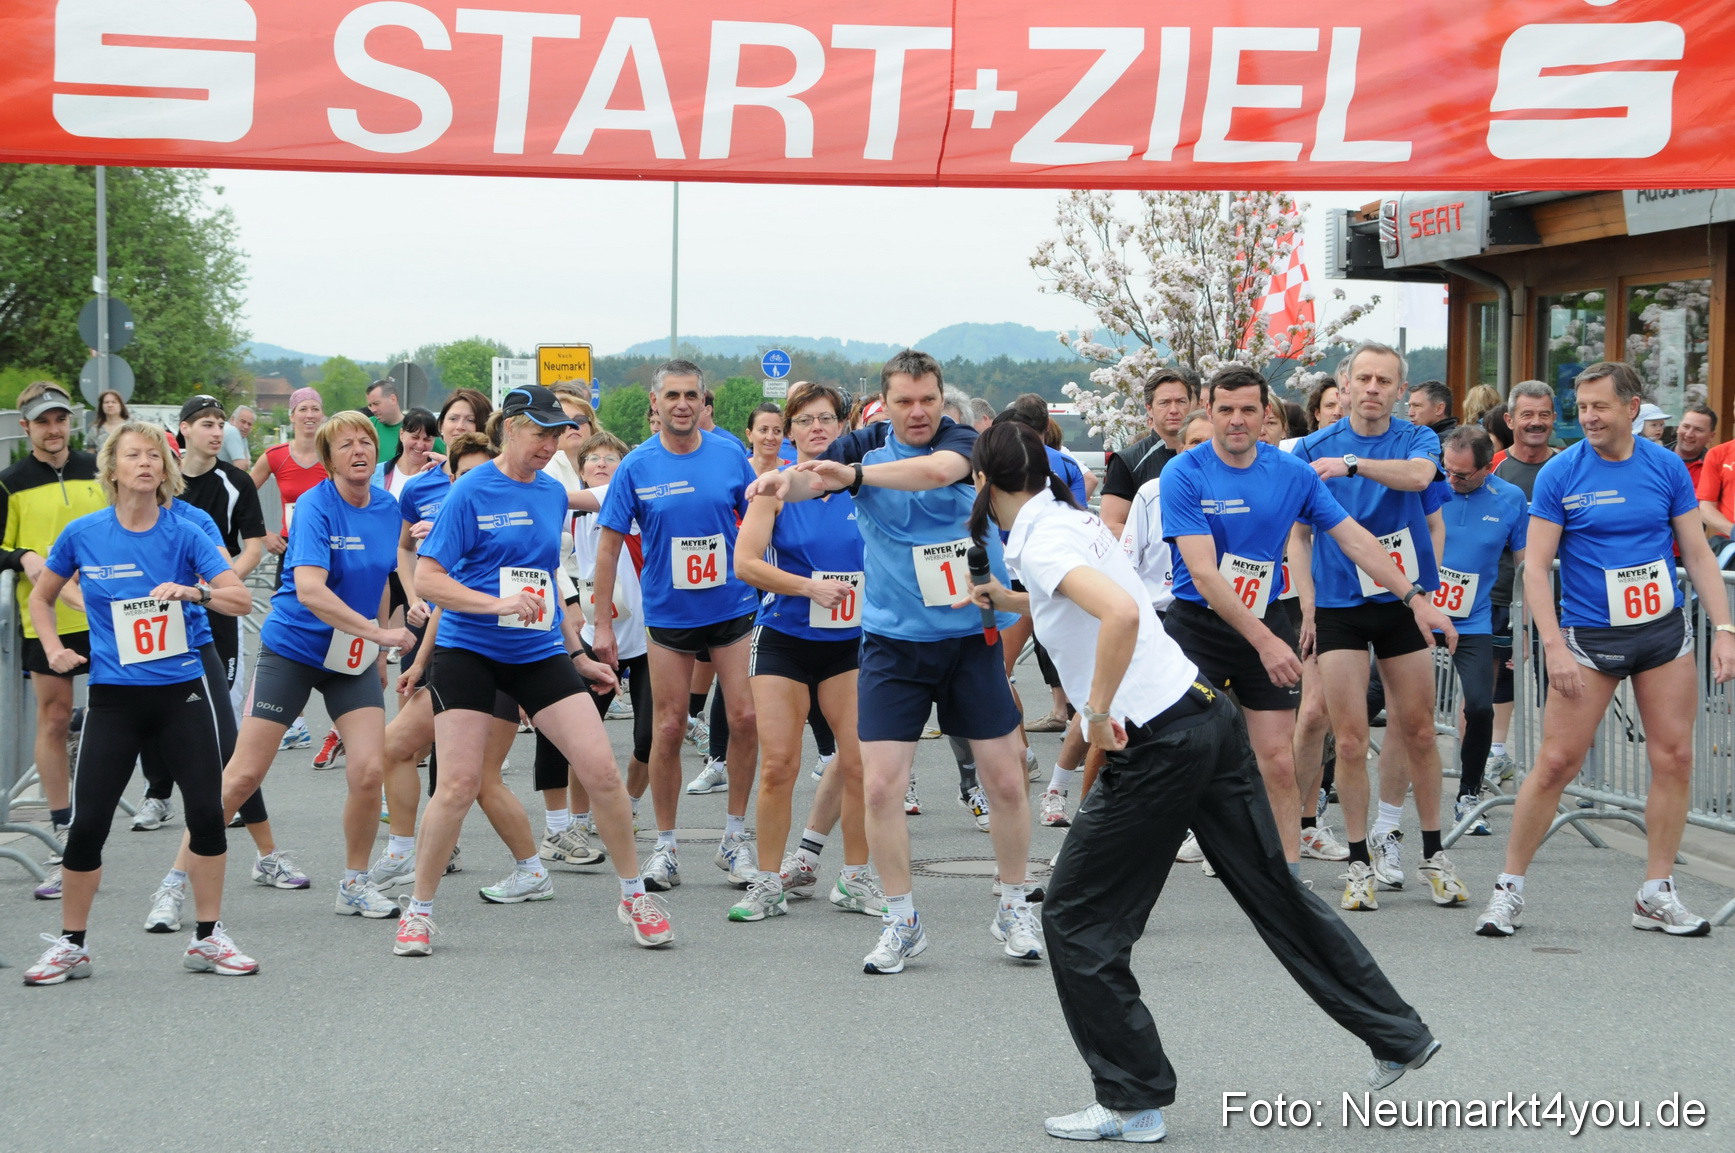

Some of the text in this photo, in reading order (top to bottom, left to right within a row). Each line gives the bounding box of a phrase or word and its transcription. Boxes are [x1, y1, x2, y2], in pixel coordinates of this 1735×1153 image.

[1409, 201, 1465, 239] SEAT
[544, 361, 586, 371] Neumarkt
[681, 539, 708, 547] MEYER
[923, 545, 952, 556] MEYER
[924, 552, 955, 561] WERBUNG
[687, 553, 717, 584] 64
[1232, 559, 1260, 571] MEYER
[511, 569, 539, 578] MEYER
[1231, 566, 1259, 577] WERBUNG
[1439, 568, 1460, 580] MEYER
[1617, 568, 1648, 579] MEYER
[940, 561, 957, 596] 1
[1617, 574, 1649, 584] WERBUNG
[1233, 576, 1260, 609] 16
[1432, 581, 1465, 611] 93
[123, 600, 156, 611] MEYER
[1624, 582, 1661, 619] 66
[123, 606, 158, 616] WERBUNG
[133, 615, 168, 655] 67
[346, 637, 364, 669] 9
[256, 701, 283, 713] ODLO
